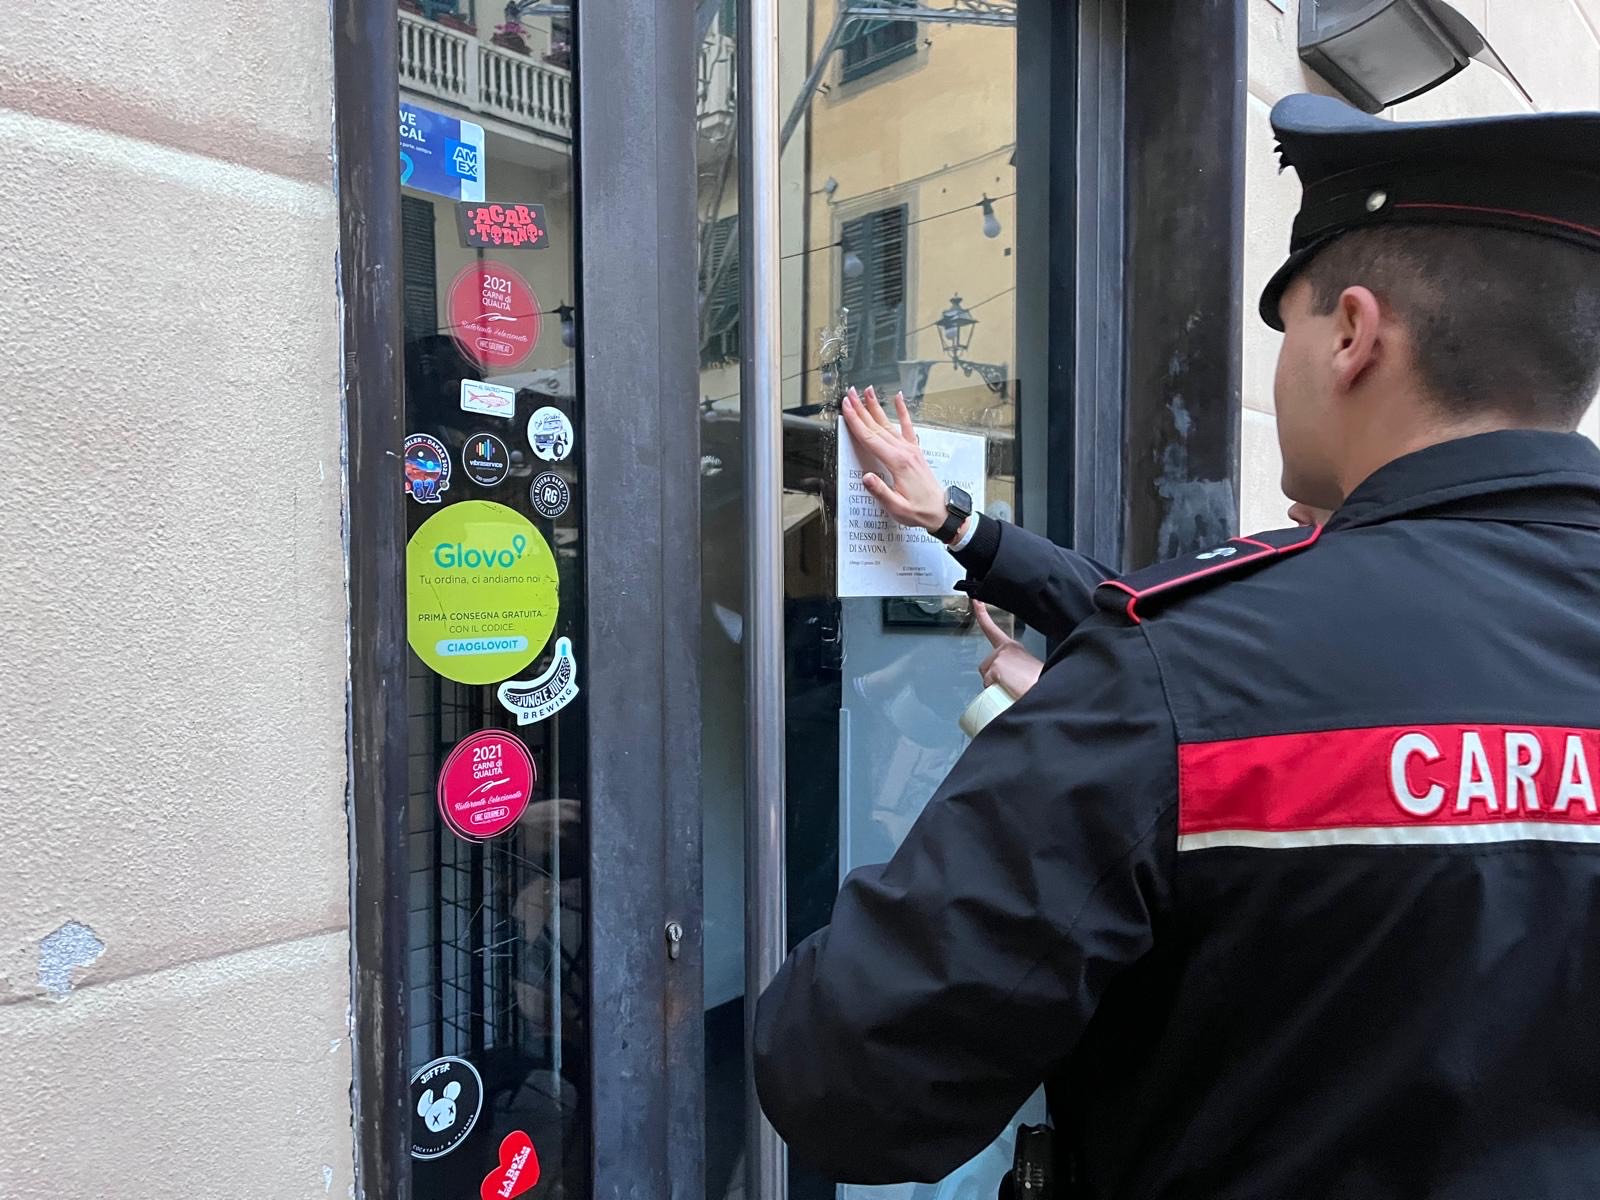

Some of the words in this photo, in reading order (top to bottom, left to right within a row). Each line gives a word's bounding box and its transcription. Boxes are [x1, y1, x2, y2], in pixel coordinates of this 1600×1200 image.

[453, 146, 477, 164] AM
[474, 205, 531, 228] ACAB
[483, 274, 511, 294] 2021
[482, 289, 504, 301] CARNI
[427, 439, 445, 458] DAKAR
[413, 479, 436, 499] 82
[544, 487, 558, 504] RG
[849, 507, 860, 516] 100
[849, 533, 876, 541] EMESSO
[434, 542, 515, 568] Glovo
[849, 545, 858, 553] DI
[859, 545, 887, 554] SAVONA
[420, 575, 431, 585] Tu
[434, 574, 469, 585] ordina,
[472, 575, 481, 583] ci
[483, 574, 523, 584] andiamo
[526, 575, 541, 583] noi
[418, 613, 447, 622] PRIMA
[450, 611, 499, 621] CONSEGNA
[449, 625, 469, 634] CON
[471, 625, 479, 633] IL
[447, 640, 519, 652] CIAOGLOVOIT
[517, 688, 551, 708] JUNGLE
[548, 672, 569, 699] JUICE
[523, 688, 572, 719] BREWING
[473, 744, 502, 762] 2021
[472, 761, 495, 772] CARNI
[1391, 731, 1599, 817] CARA
[420, 1062, 451, 1084] JEFFER
